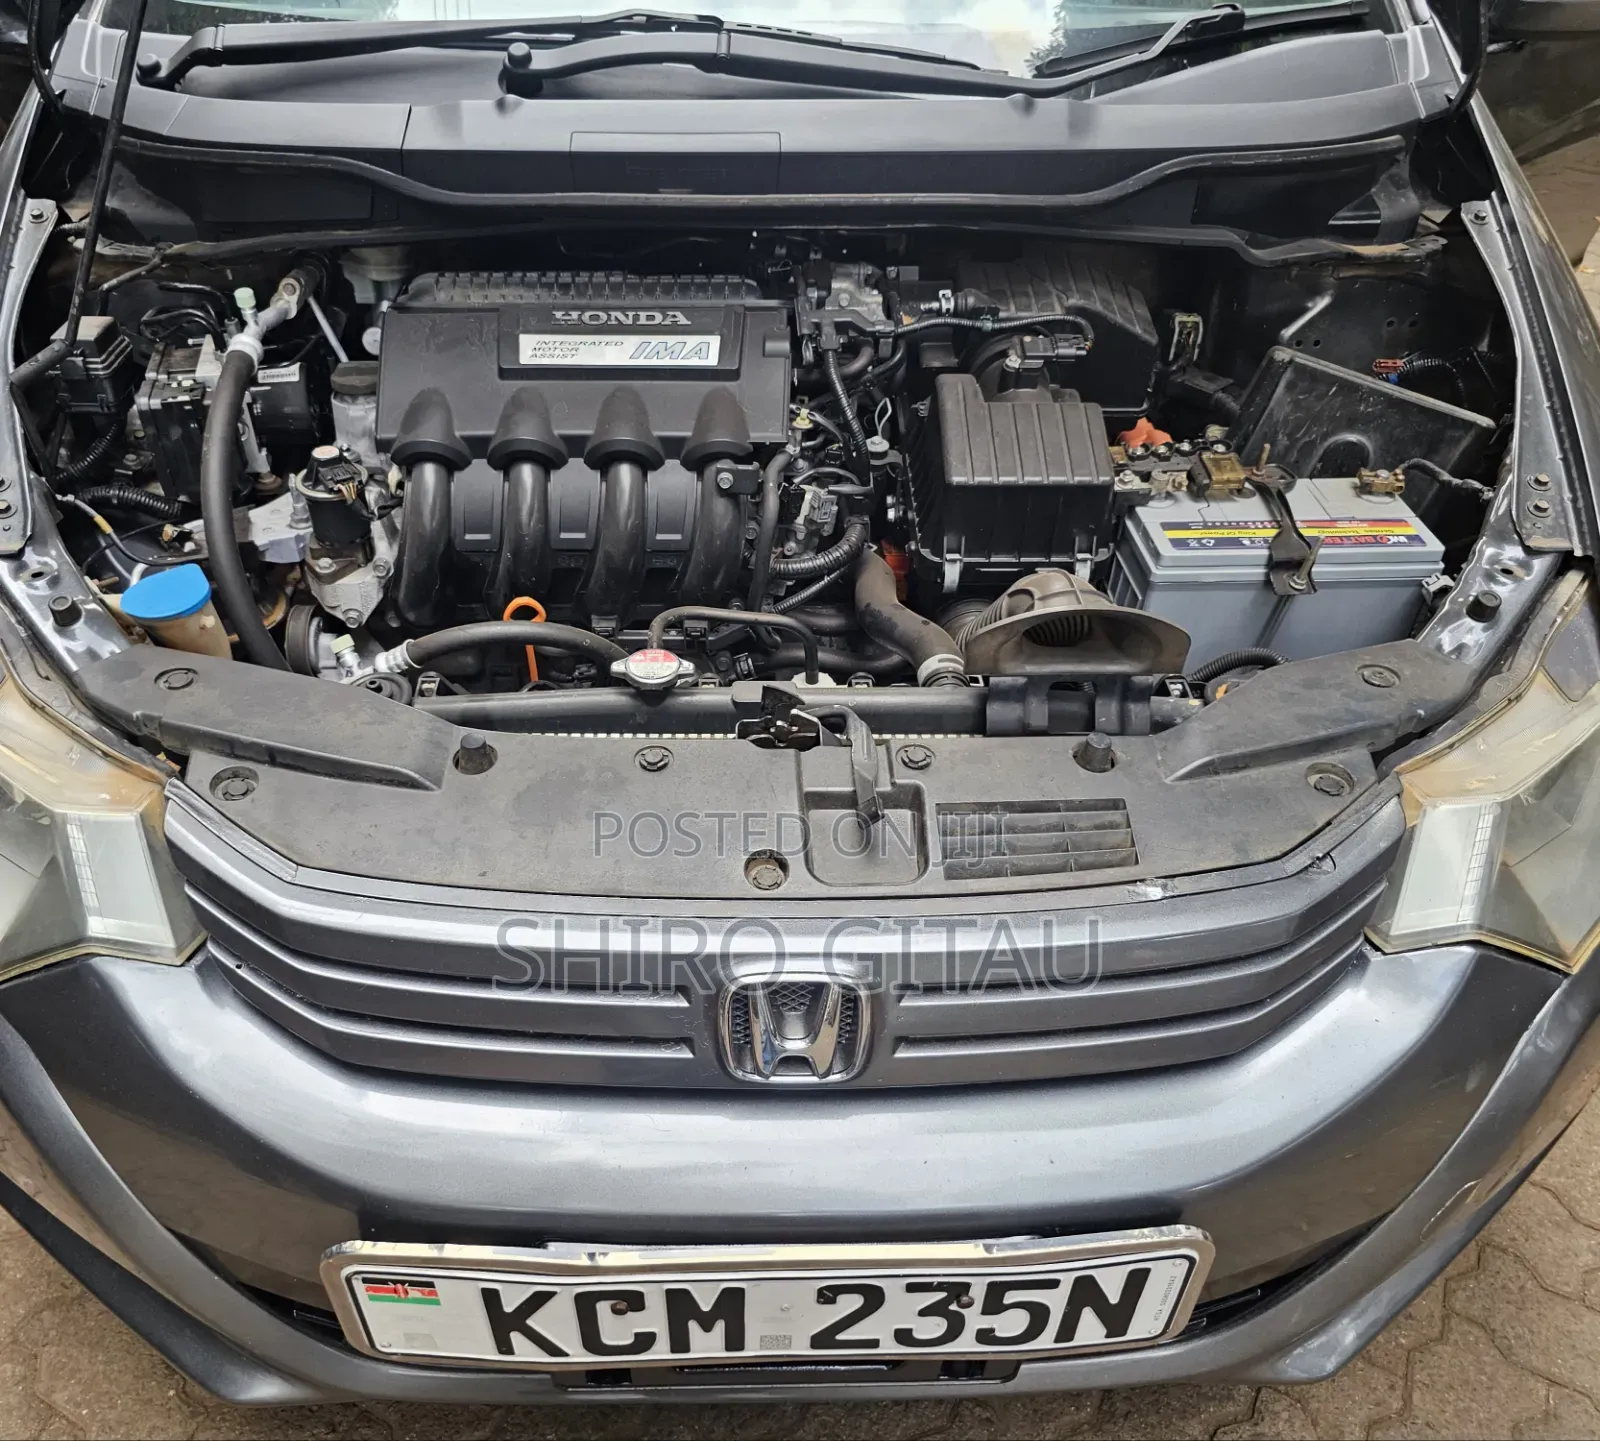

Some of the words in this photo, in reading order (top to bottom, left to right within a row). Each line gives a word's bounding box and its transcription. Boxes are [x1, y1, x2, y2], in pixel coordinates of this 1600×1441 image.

[551, 311, 692, 325] HONDA
[629, 341, 711, 360] IMA
[480, 1286, 746, 1357] KCM
[810, 1267, 1152, 1350] 235N
